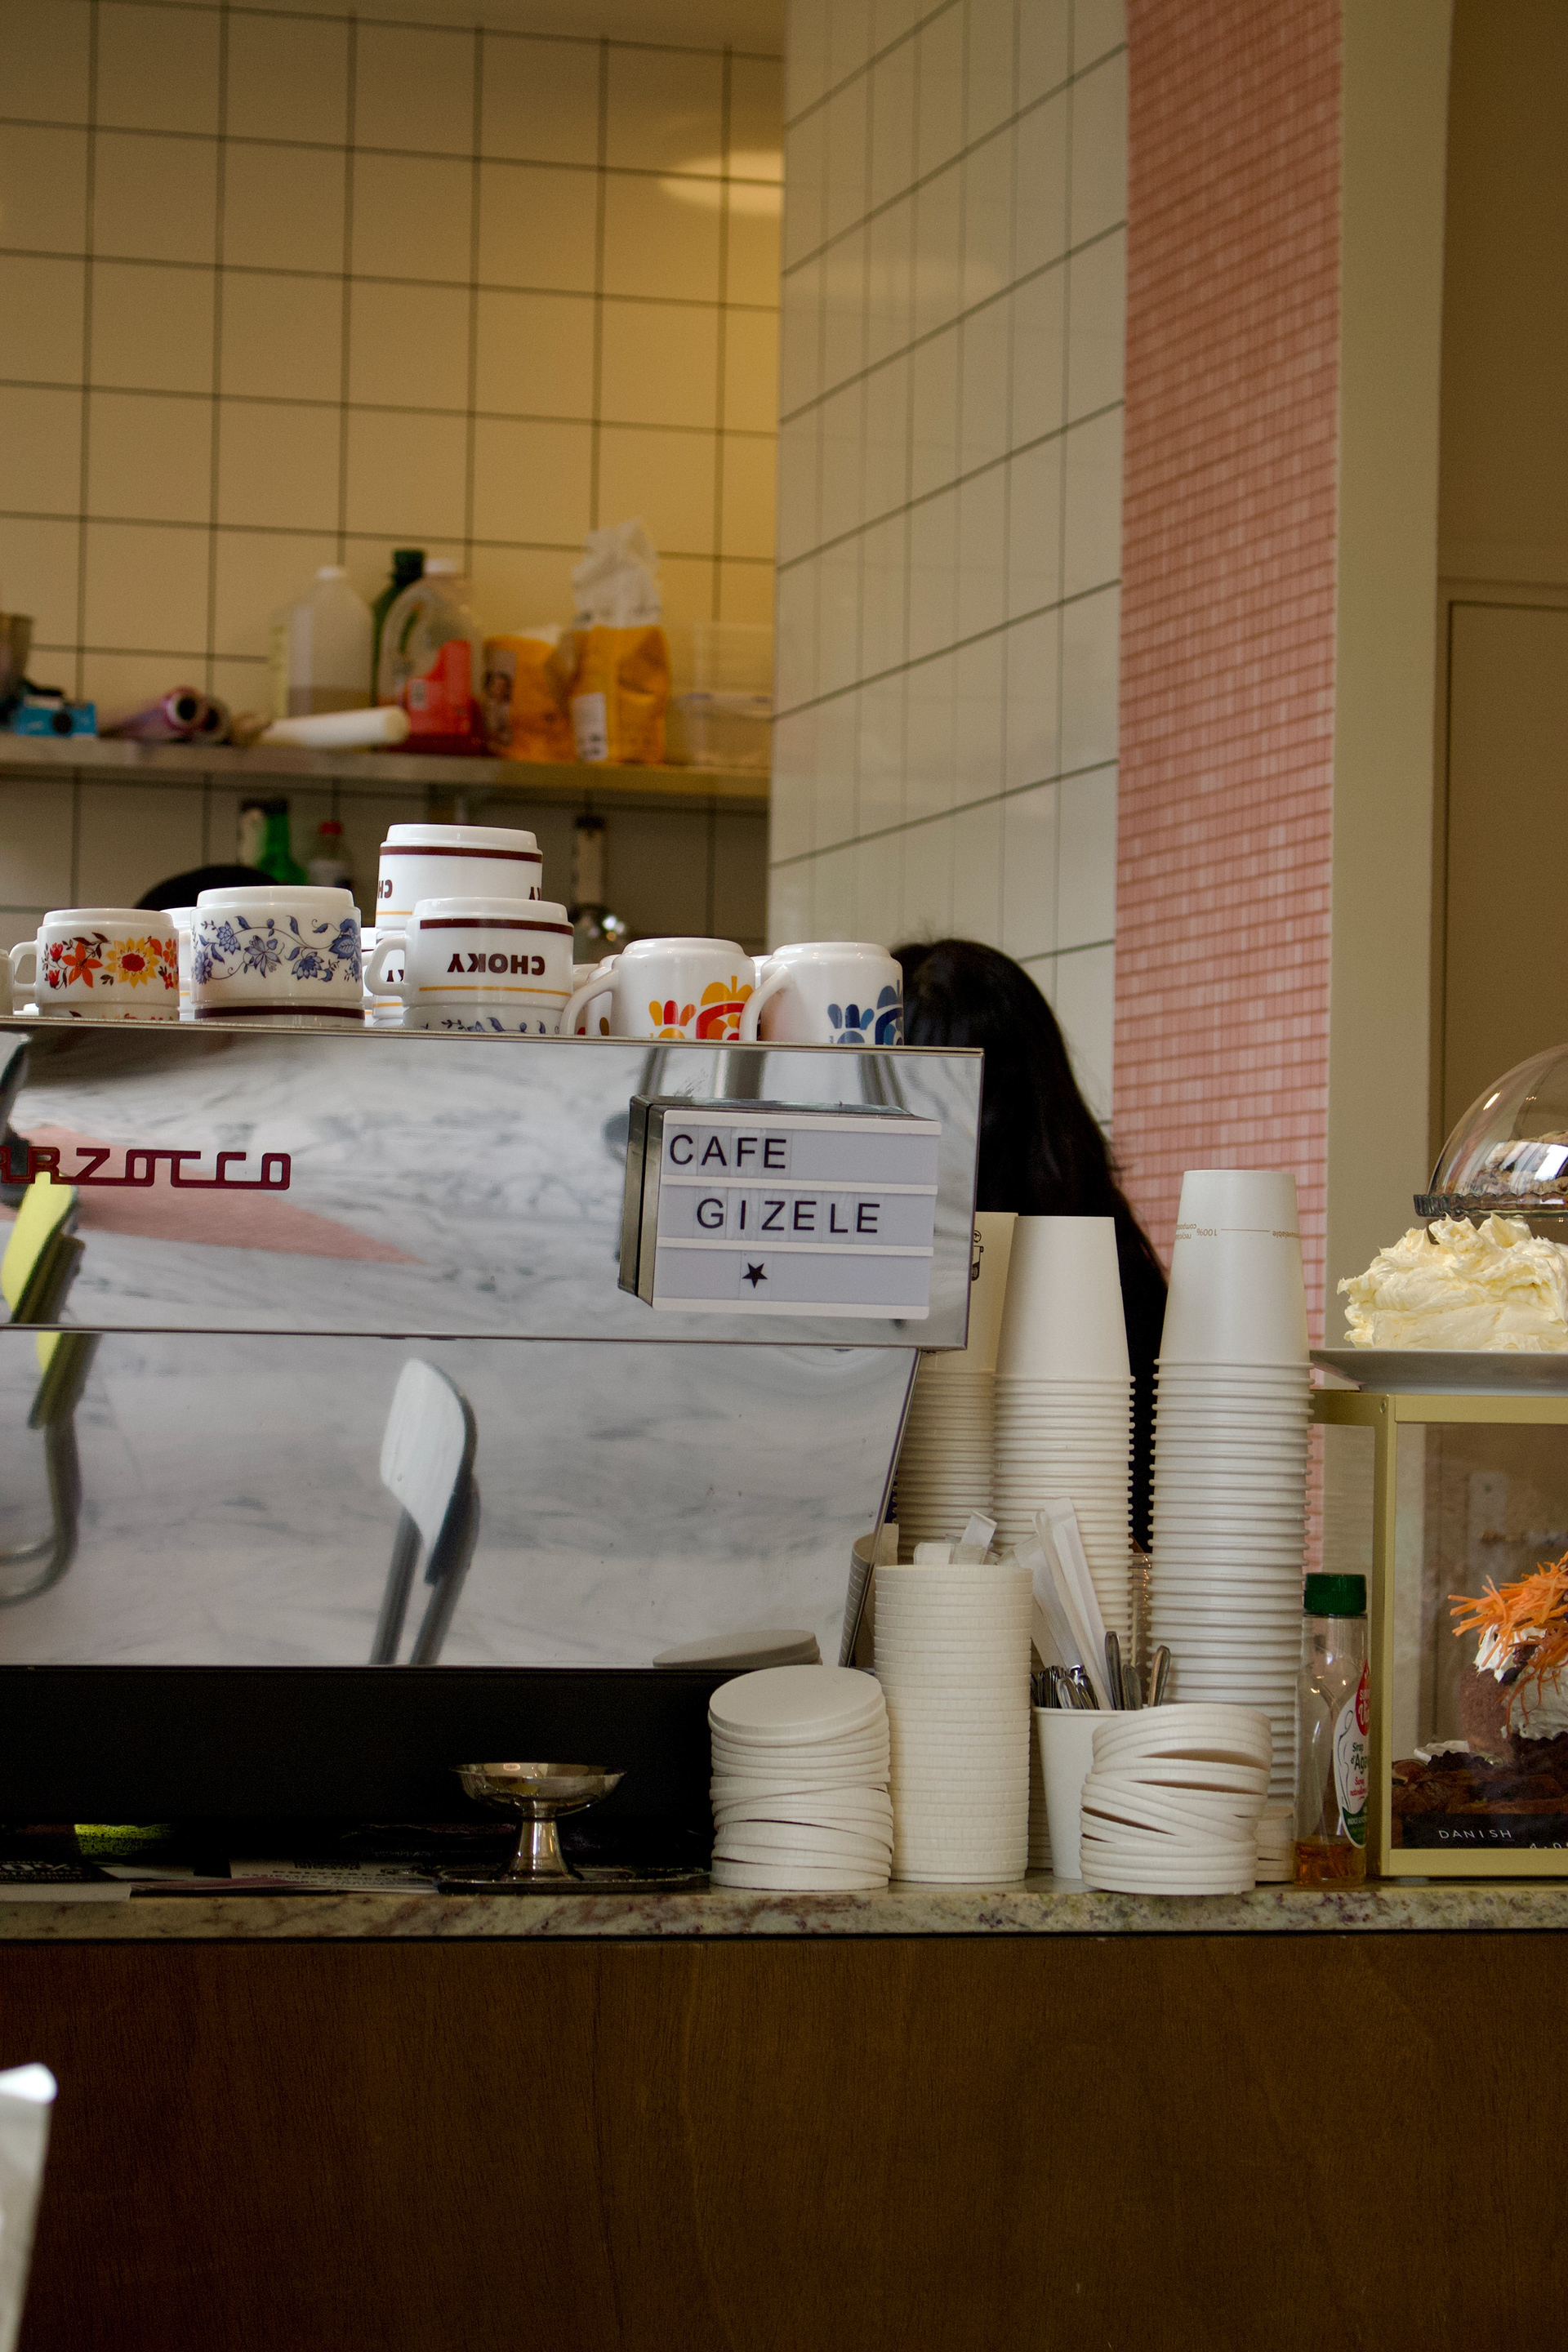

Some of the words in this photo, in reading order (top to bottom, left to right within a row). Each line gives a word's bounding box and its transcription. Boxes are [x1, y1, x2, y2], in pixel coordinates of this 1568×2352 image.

[447, 953, 546, 976] CHOKY
[670, 1134, 786, 1169] CAFE
[697, 1197, 880, 1233] GIZELE
[1196, 1227, 1218, 1237] 100%
[1438, 1829, 1512, 1839] DANISH
